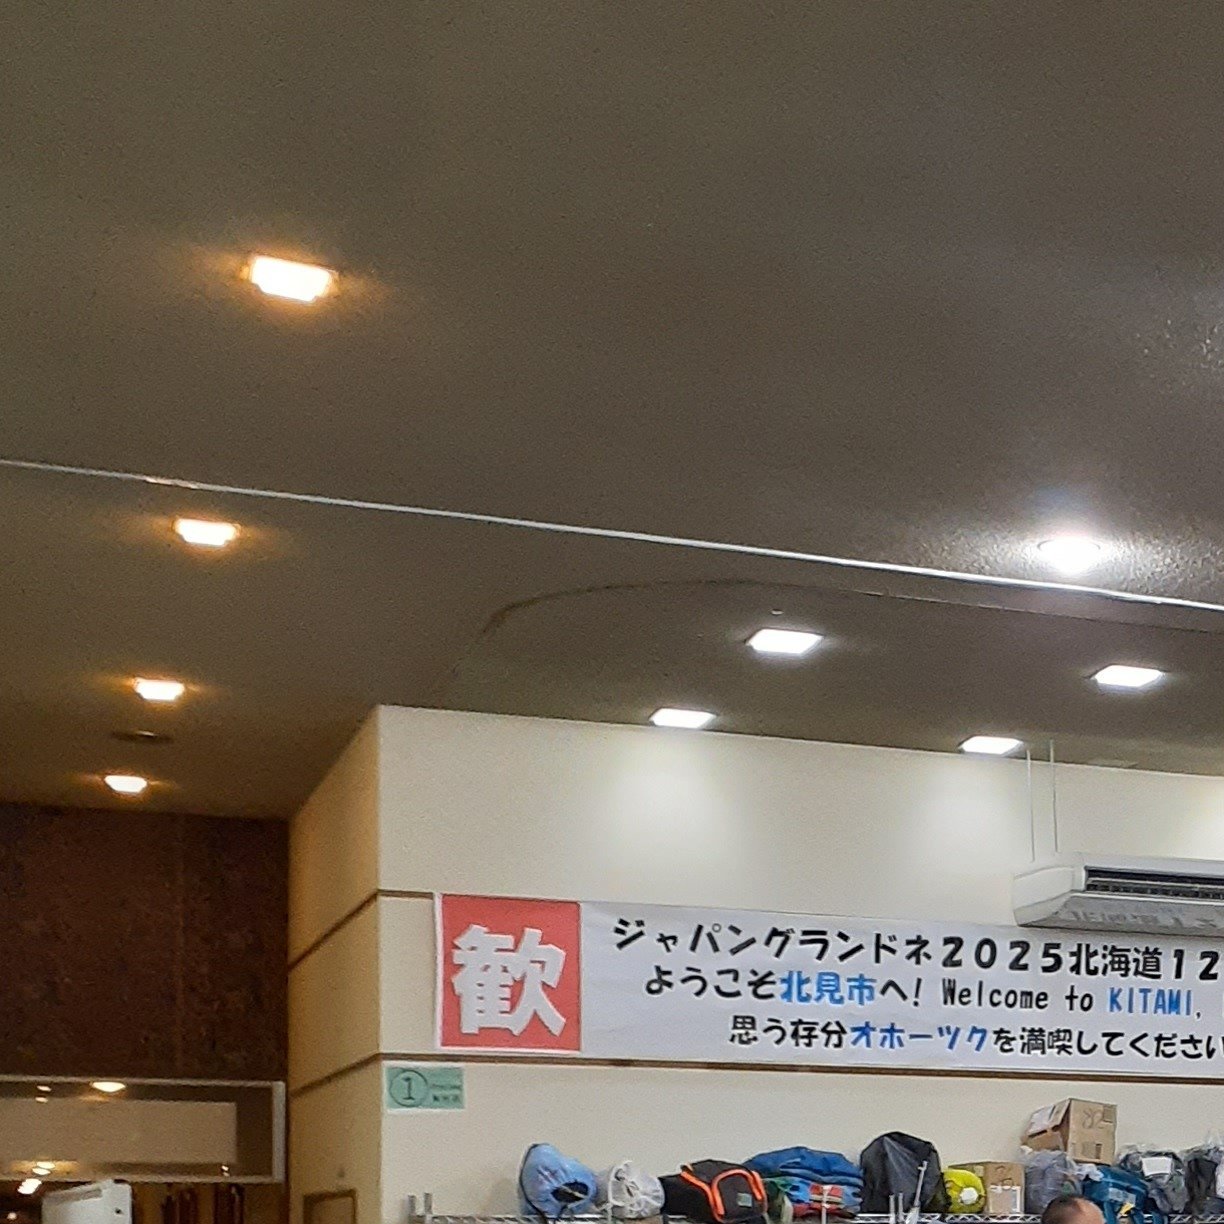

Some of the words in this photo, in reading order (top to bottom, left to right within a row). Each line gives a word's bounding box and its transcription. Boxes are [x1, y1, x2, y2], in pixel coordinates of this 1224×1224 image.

[452, 923, 567, 1037] 歓
[942, 978, 1049, 1009] Welcome
[1065, 985, 1094, 1012] to
[1109, 986, 1202, 1019] KITAMI,
